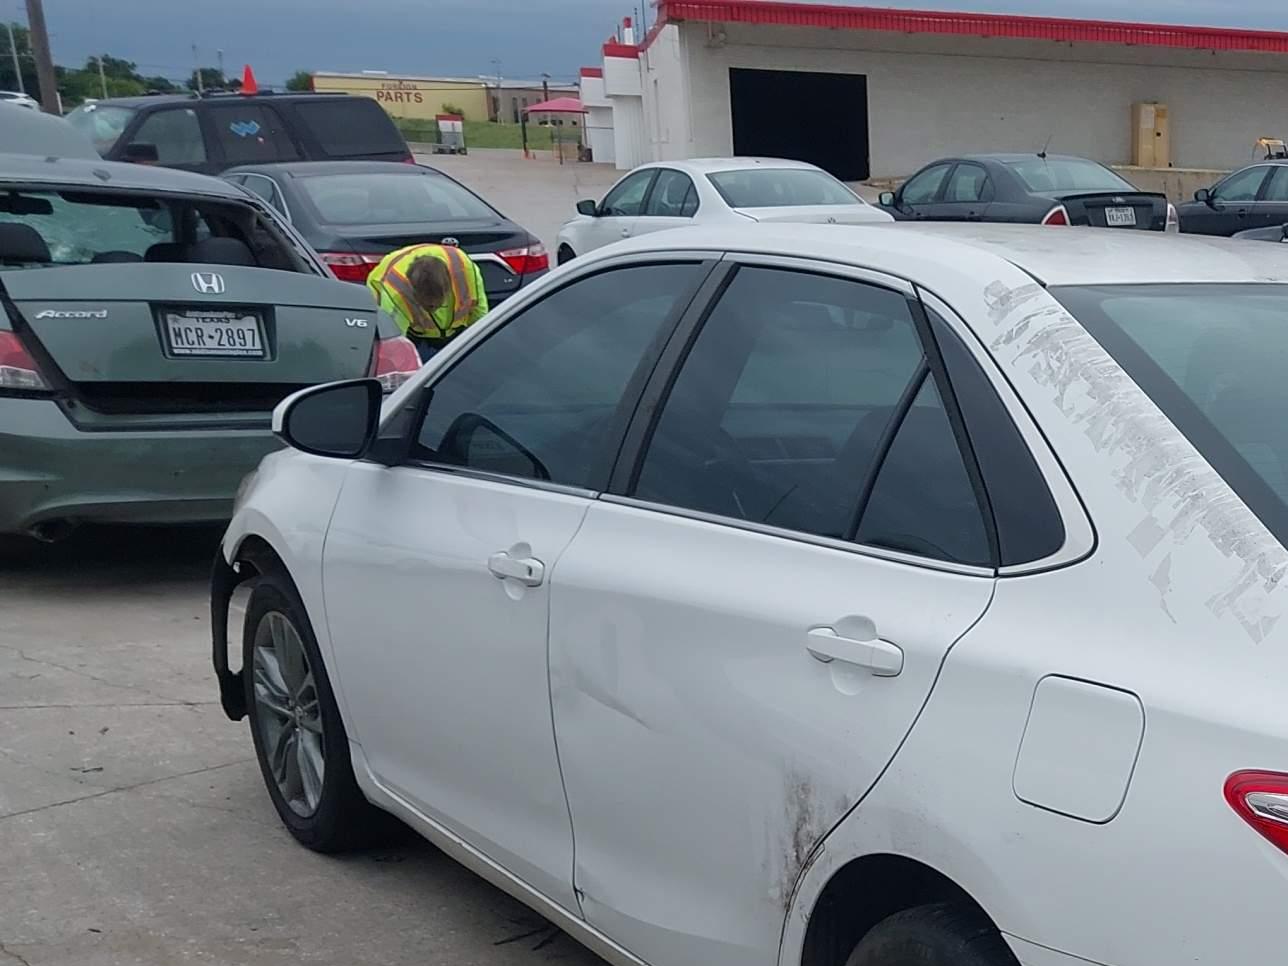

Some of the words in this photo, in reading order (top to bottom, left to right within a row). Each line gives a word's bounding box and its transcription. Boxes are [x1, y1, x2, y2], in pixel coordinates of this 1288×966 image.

[376, 90, 424, 104] PARTS
[35, 309, 108, 319] Accord
[345, 317, 369, 327] V6
